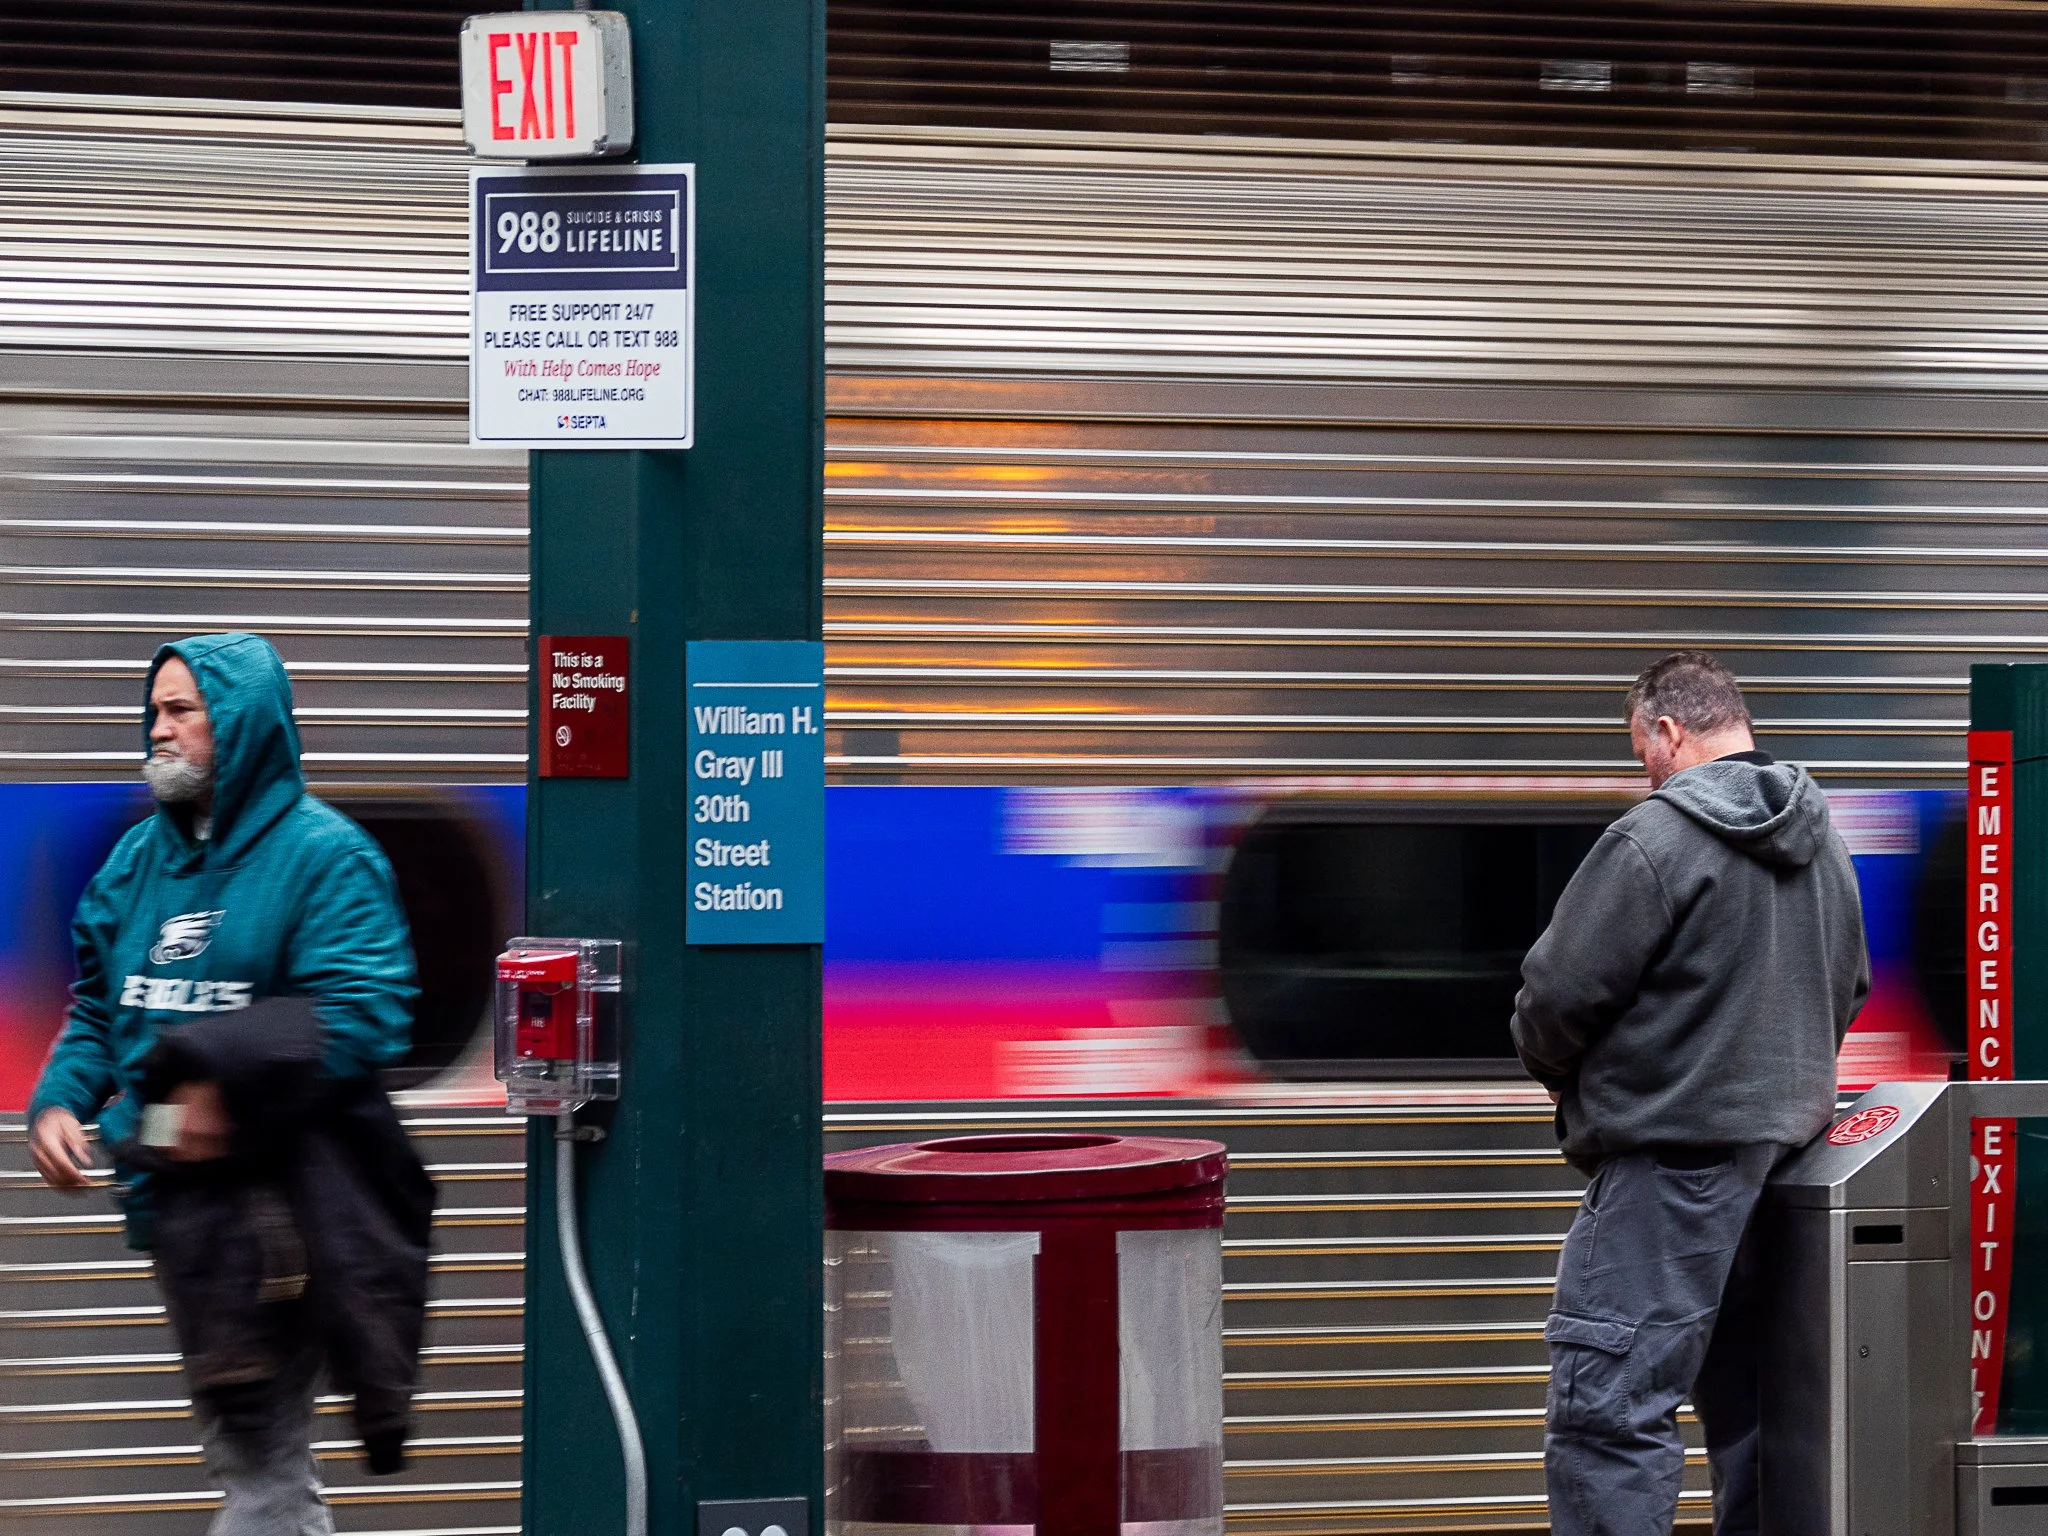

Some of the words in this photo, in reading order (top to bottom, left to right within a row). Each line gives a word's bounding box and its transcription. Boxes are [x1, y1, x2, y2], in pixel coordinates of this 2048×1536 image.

[487, 31, 578, 140] EXIT
[566, 210, 613, 224] SUICIDE
[614, 210, 621, 223] &
[624, 209, 663, 223] CRISIS
[497, 211, 561, 253] 988
[566, 229, 663, 253] LIFELINE
[509, 304, 547, 321] FREE
[552, 303, 621, 321] SUPPORT
[625, 303, 655, 321] 24/7
[484, 331, 541, 348] PLEASE
[546, 331, 583, 348] CALL
[587, 331, 609, 348] OR
[613, 330, 650, 348] TEXT
[654, 330, 679, 348] 988
[504, 359, 537, 377] With
[541, 359, 574, 382] Help
[577, 359, 621, 377] Comes
[625, 359, 661, 382] Hope
[518, 388, 549, 402] CHAT:
[552, 388, 645, 402] 988LIFELINE.ORG
[570, 415, 607, 429] SEPTA
[552, 652, 579, 668] This
[581, 652, 594, 668] is
[594, 654, 604, 668] a
[552, 672, 571, 689] No
[572, 672, 626, 693] Smoking
[552, 693, 597, 713] Facility
[693, 706, 786, 734] William
[791, 706, 819, 734] H.
[694, 750, 756, 785] Gray
[761, 750, 784, 778] III
[694, 794, 750, 823] 30th
[694, 838, 771, 867] Street
[694, 882, 784, 911] Station
[1977, 767, 2001, 1082] EMERGENC
[1980, 1125, 2003, 1272] EXIT
